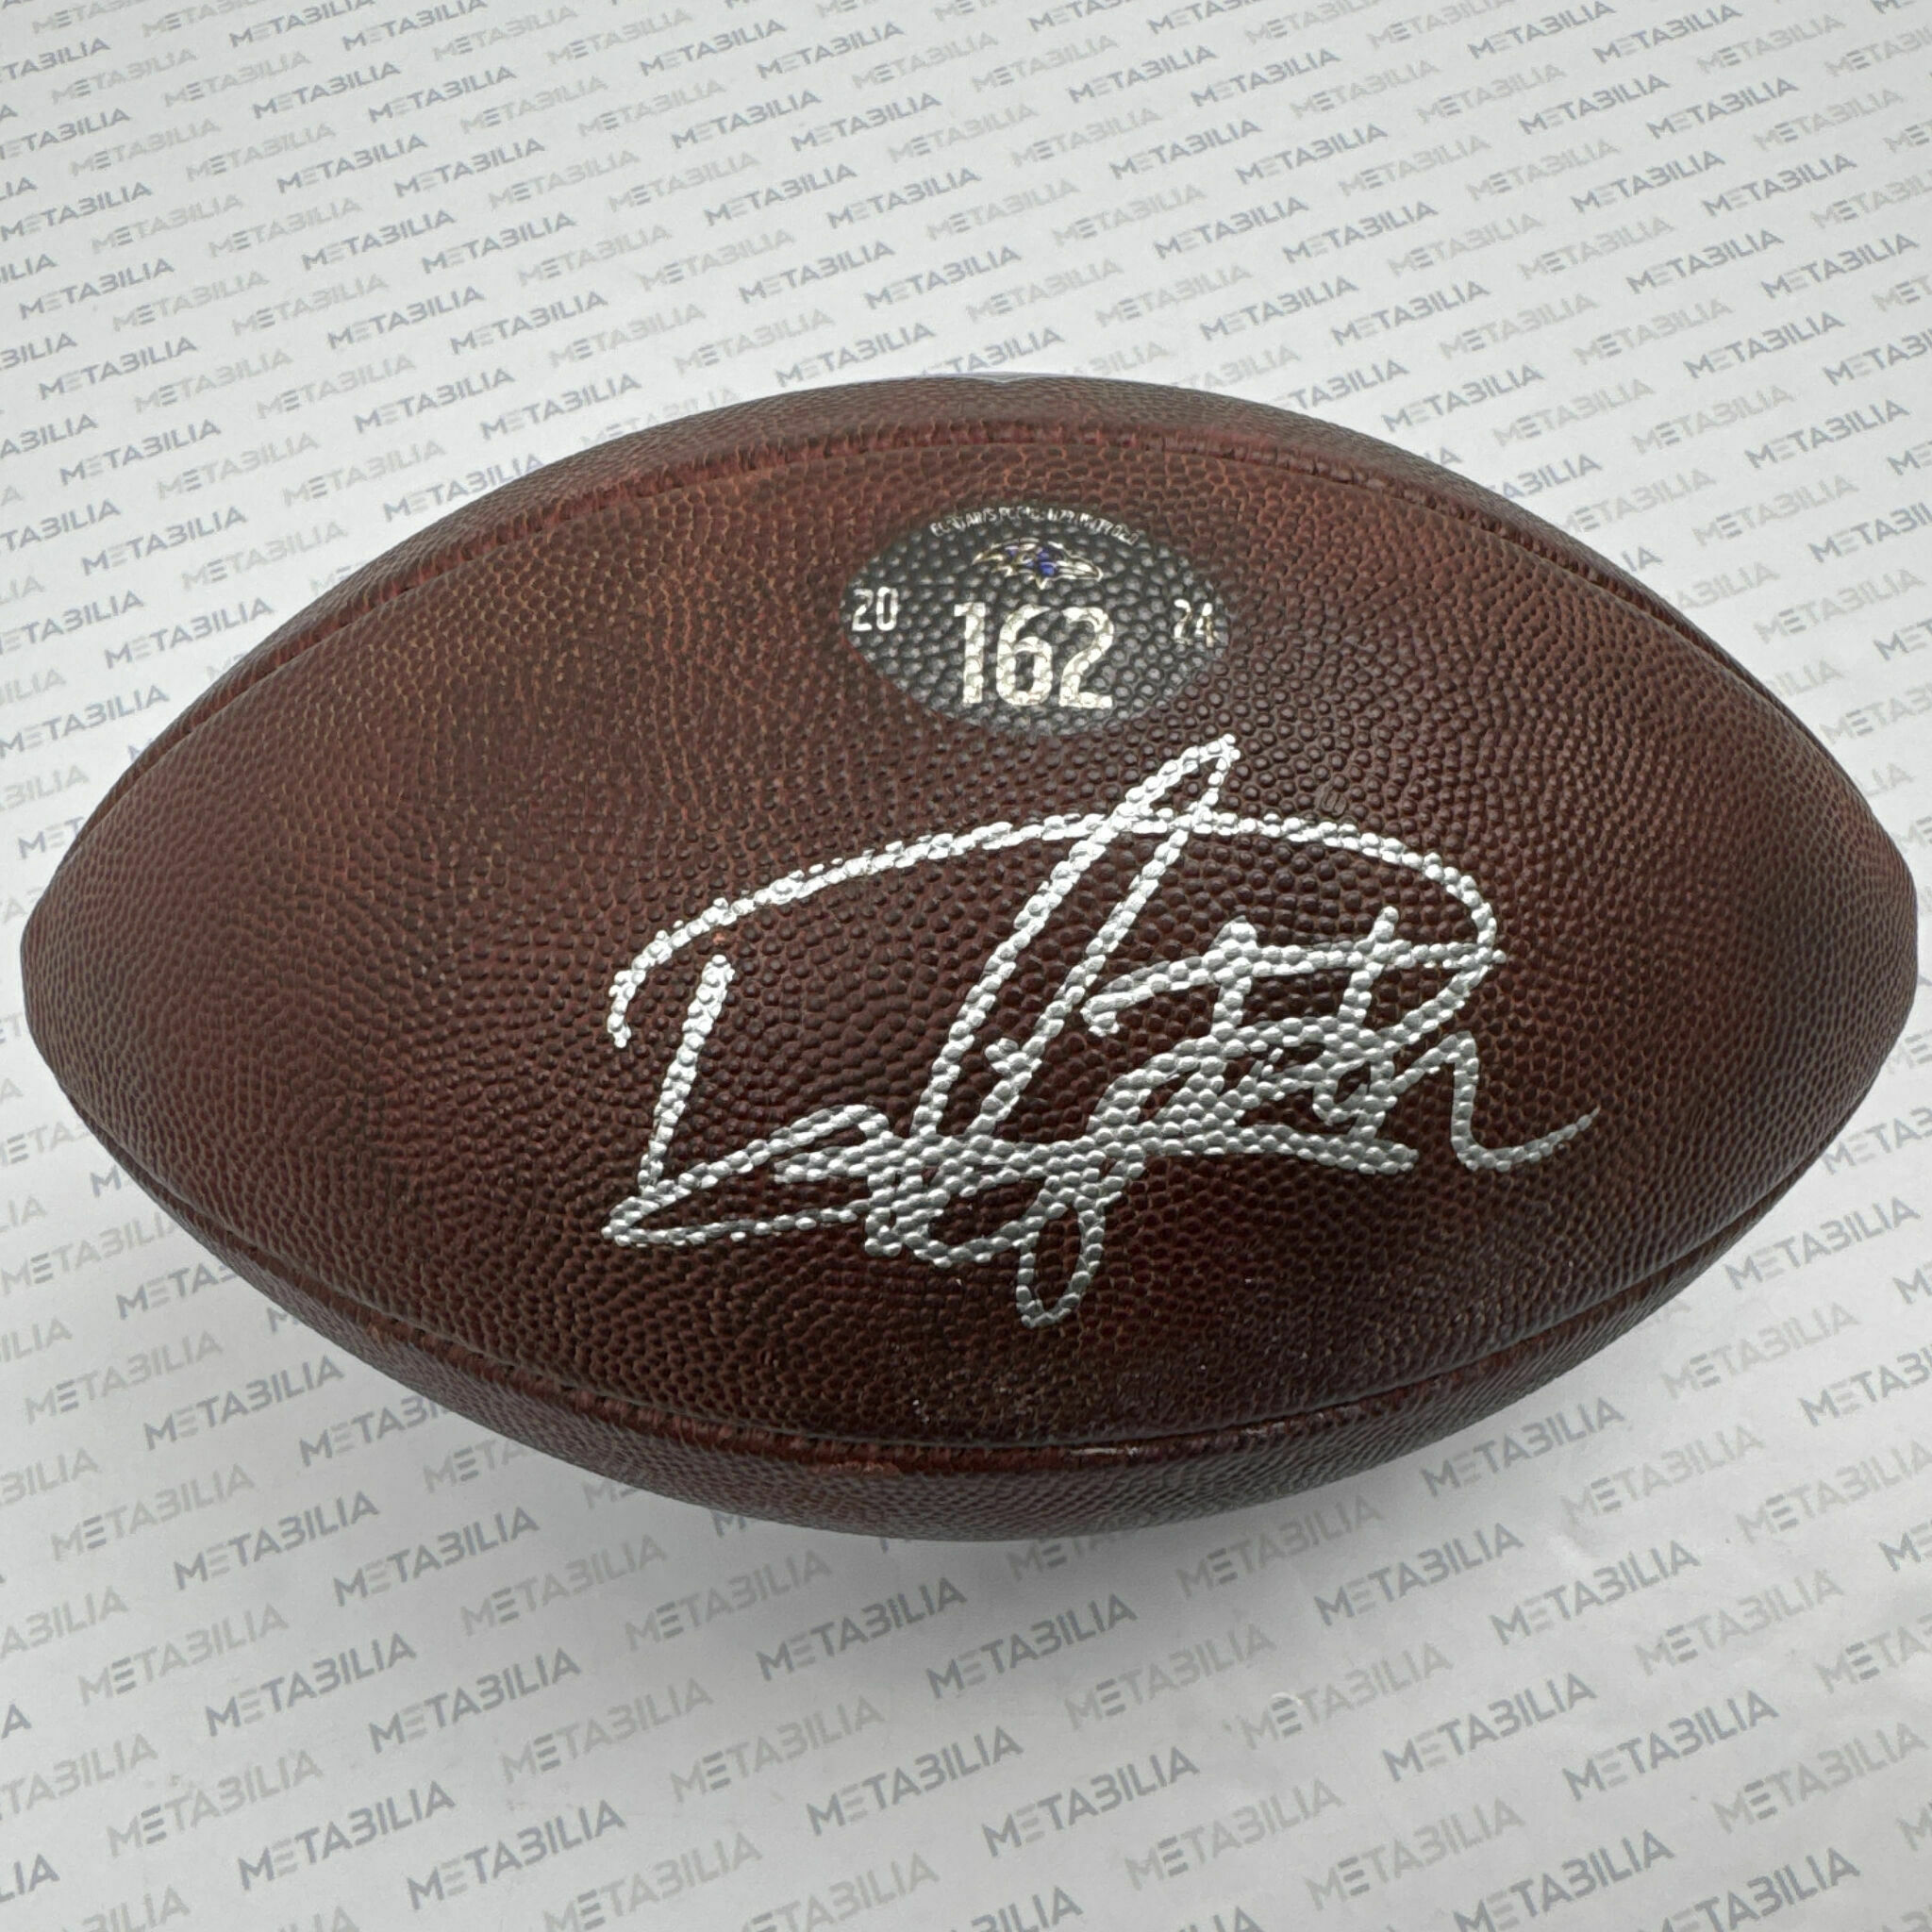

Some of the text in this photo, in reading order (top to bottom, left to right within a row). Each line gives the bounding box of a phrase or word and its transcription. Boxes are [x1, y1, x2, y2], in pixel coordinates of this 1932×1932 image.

[2, 38, 111, 80] TABILIA
[0, 413, 99, 460] ABILIA
[0, 499, 122, 552] TABILIA
[851, 586, 899, 631] 20
[954, 602, 1114, 708] 162
[0, 1587, 128, 1660] ABILIA
[0, 1734, 158, 1822] TABILIA
